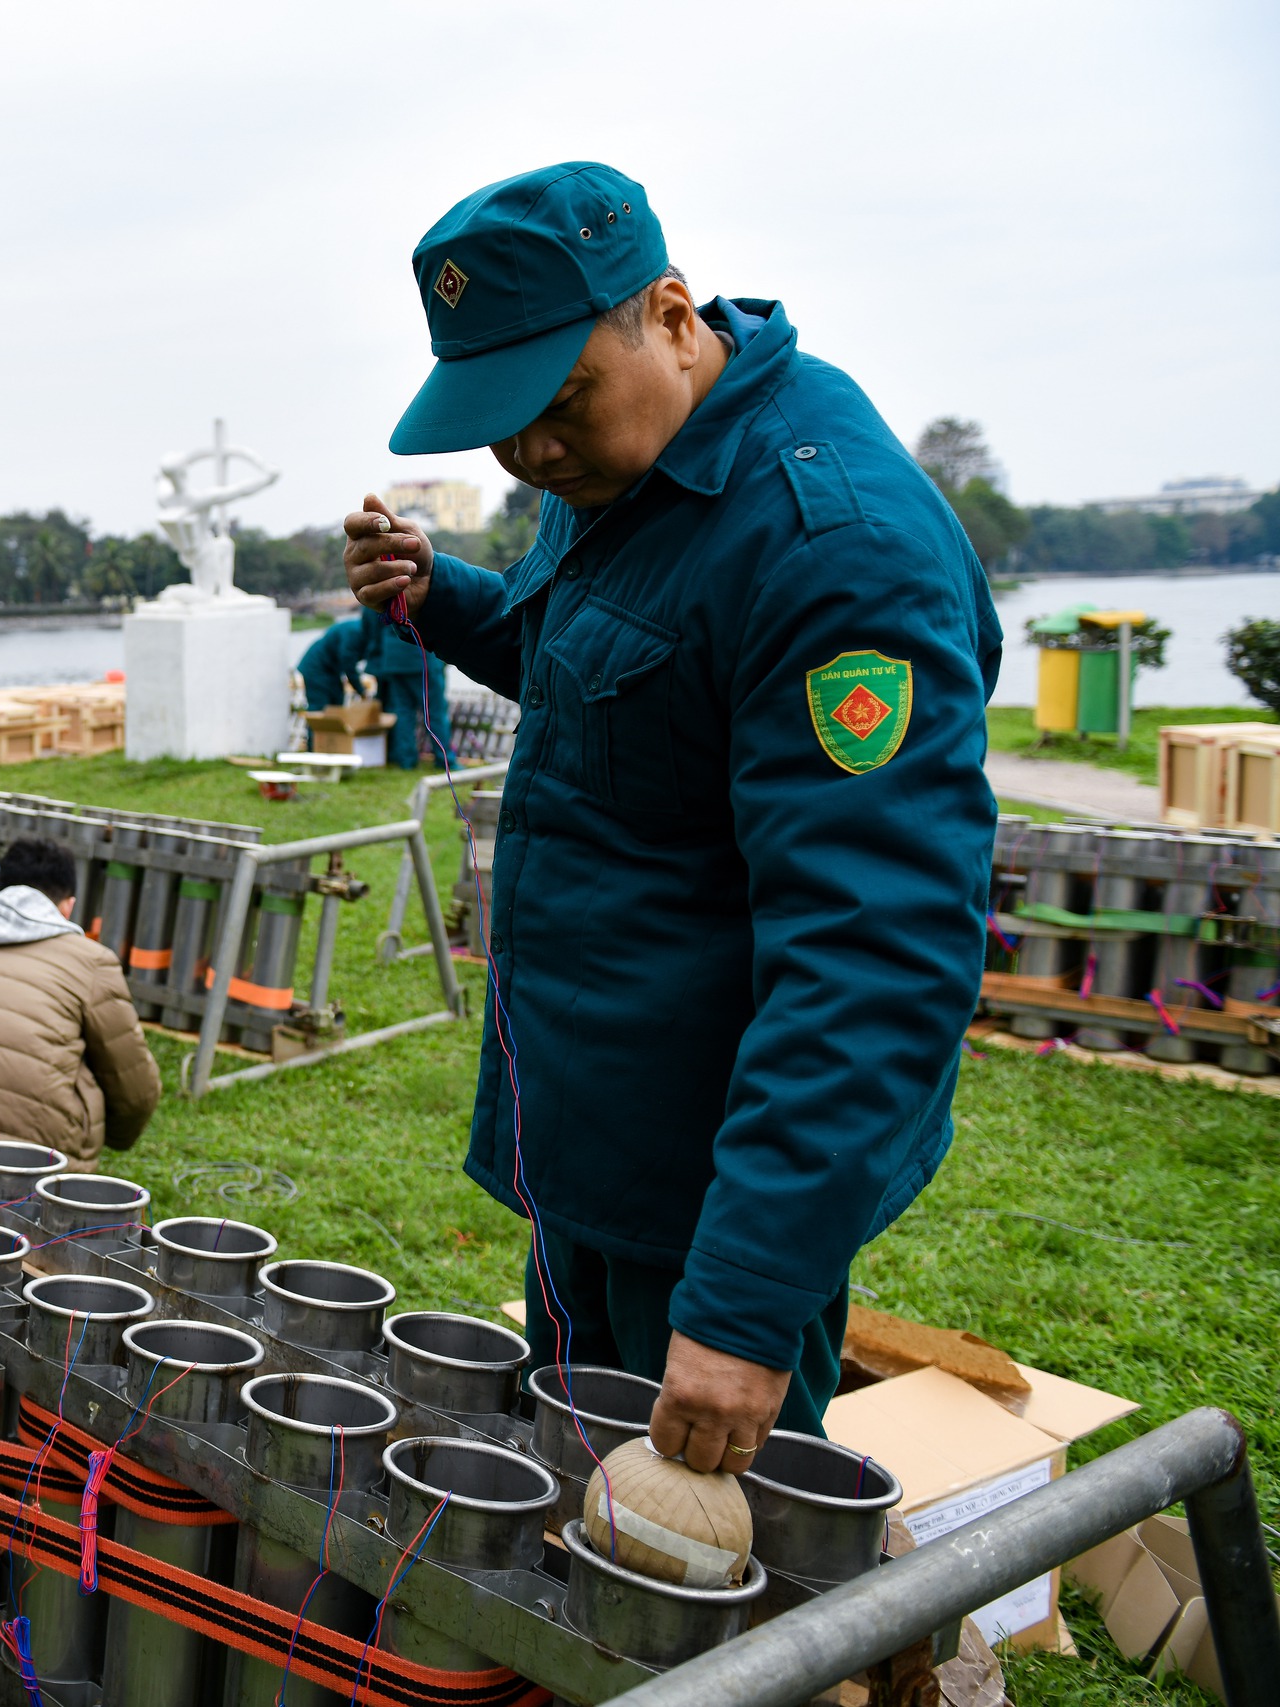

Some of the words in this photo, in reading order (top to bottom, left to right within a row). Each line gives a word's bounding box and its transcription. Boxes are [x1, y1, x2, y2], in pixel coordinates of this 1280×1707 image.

[821, 670, 841, 681] DÂN
[843, 667, 869, 678] QUÂN
[872, 666, 884, 676] TỰ
[885, 664, 896, 675] VỆ
